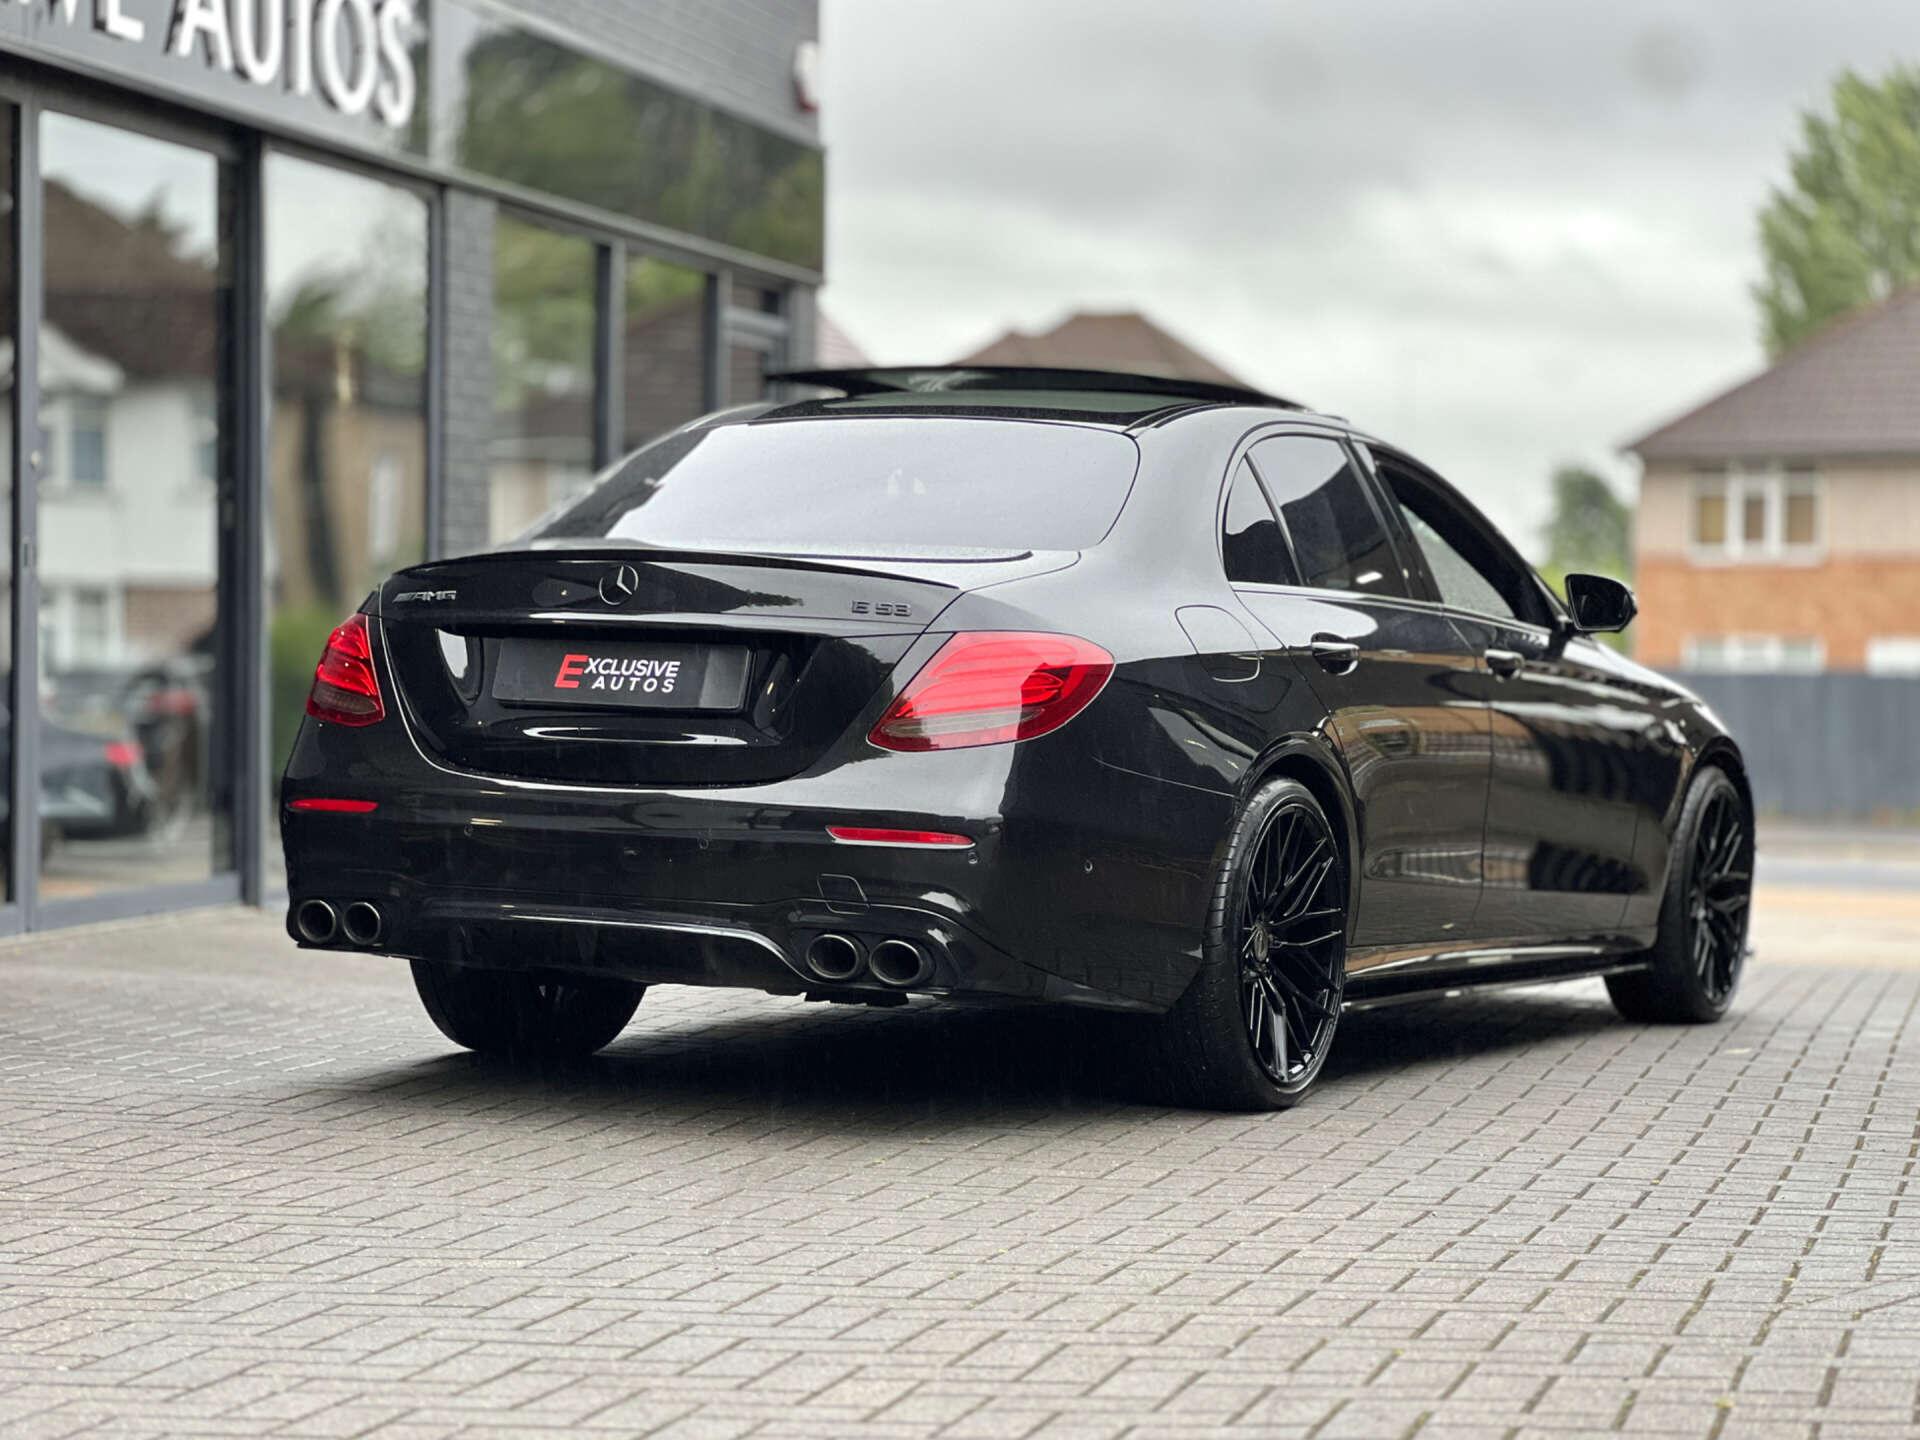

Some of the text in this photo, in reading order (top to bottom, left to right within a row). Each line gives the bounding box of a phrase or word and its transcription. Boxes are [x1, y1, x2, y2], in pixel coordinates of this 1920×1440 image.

[851, 600, 912, 617] E 53
[554, 654, 680, 688] EXCLUSIVE
[591, 676, 675, 693] AUTOS
